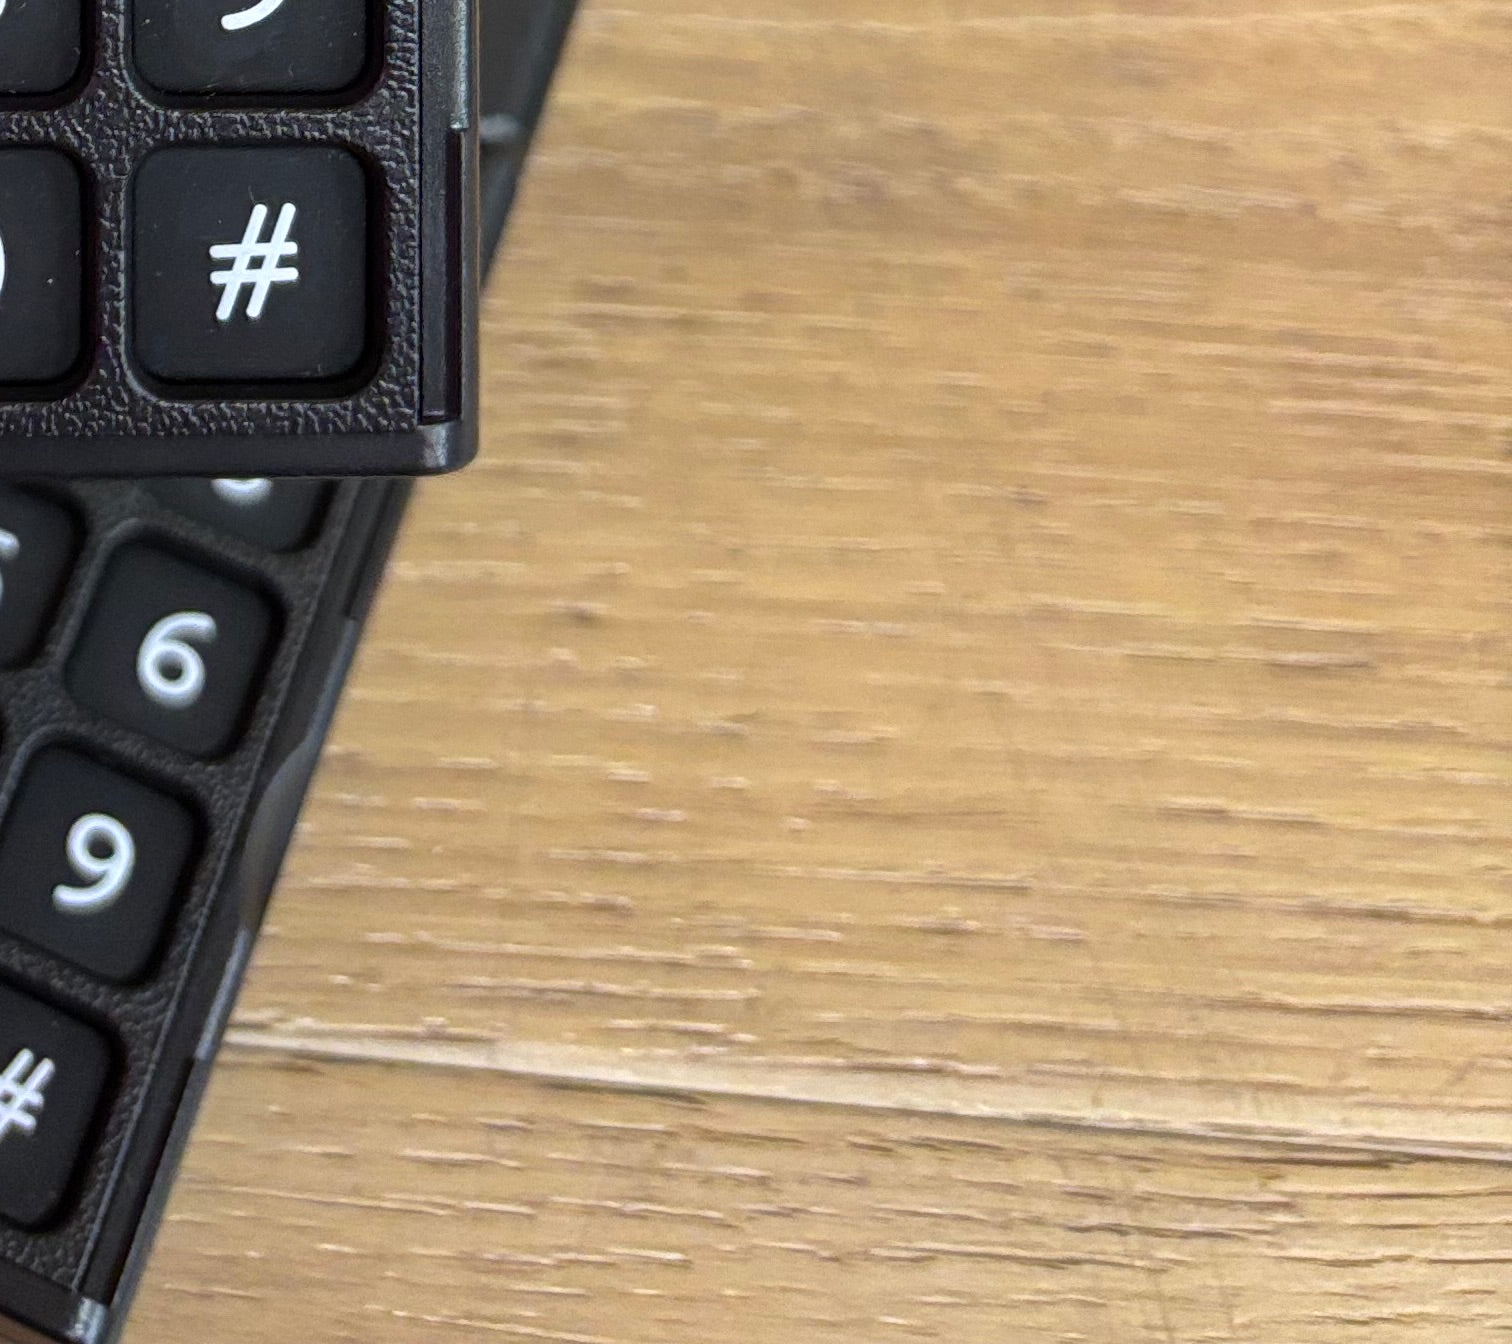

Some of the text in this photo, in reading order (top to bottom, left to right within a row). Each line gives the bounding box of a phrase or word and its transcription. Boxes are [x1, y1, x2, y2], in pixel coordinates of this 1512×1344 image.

[209, 202, 299, 321] #
[135, 610, 218, 706] 6
[51, 811, 137, 911] 9
